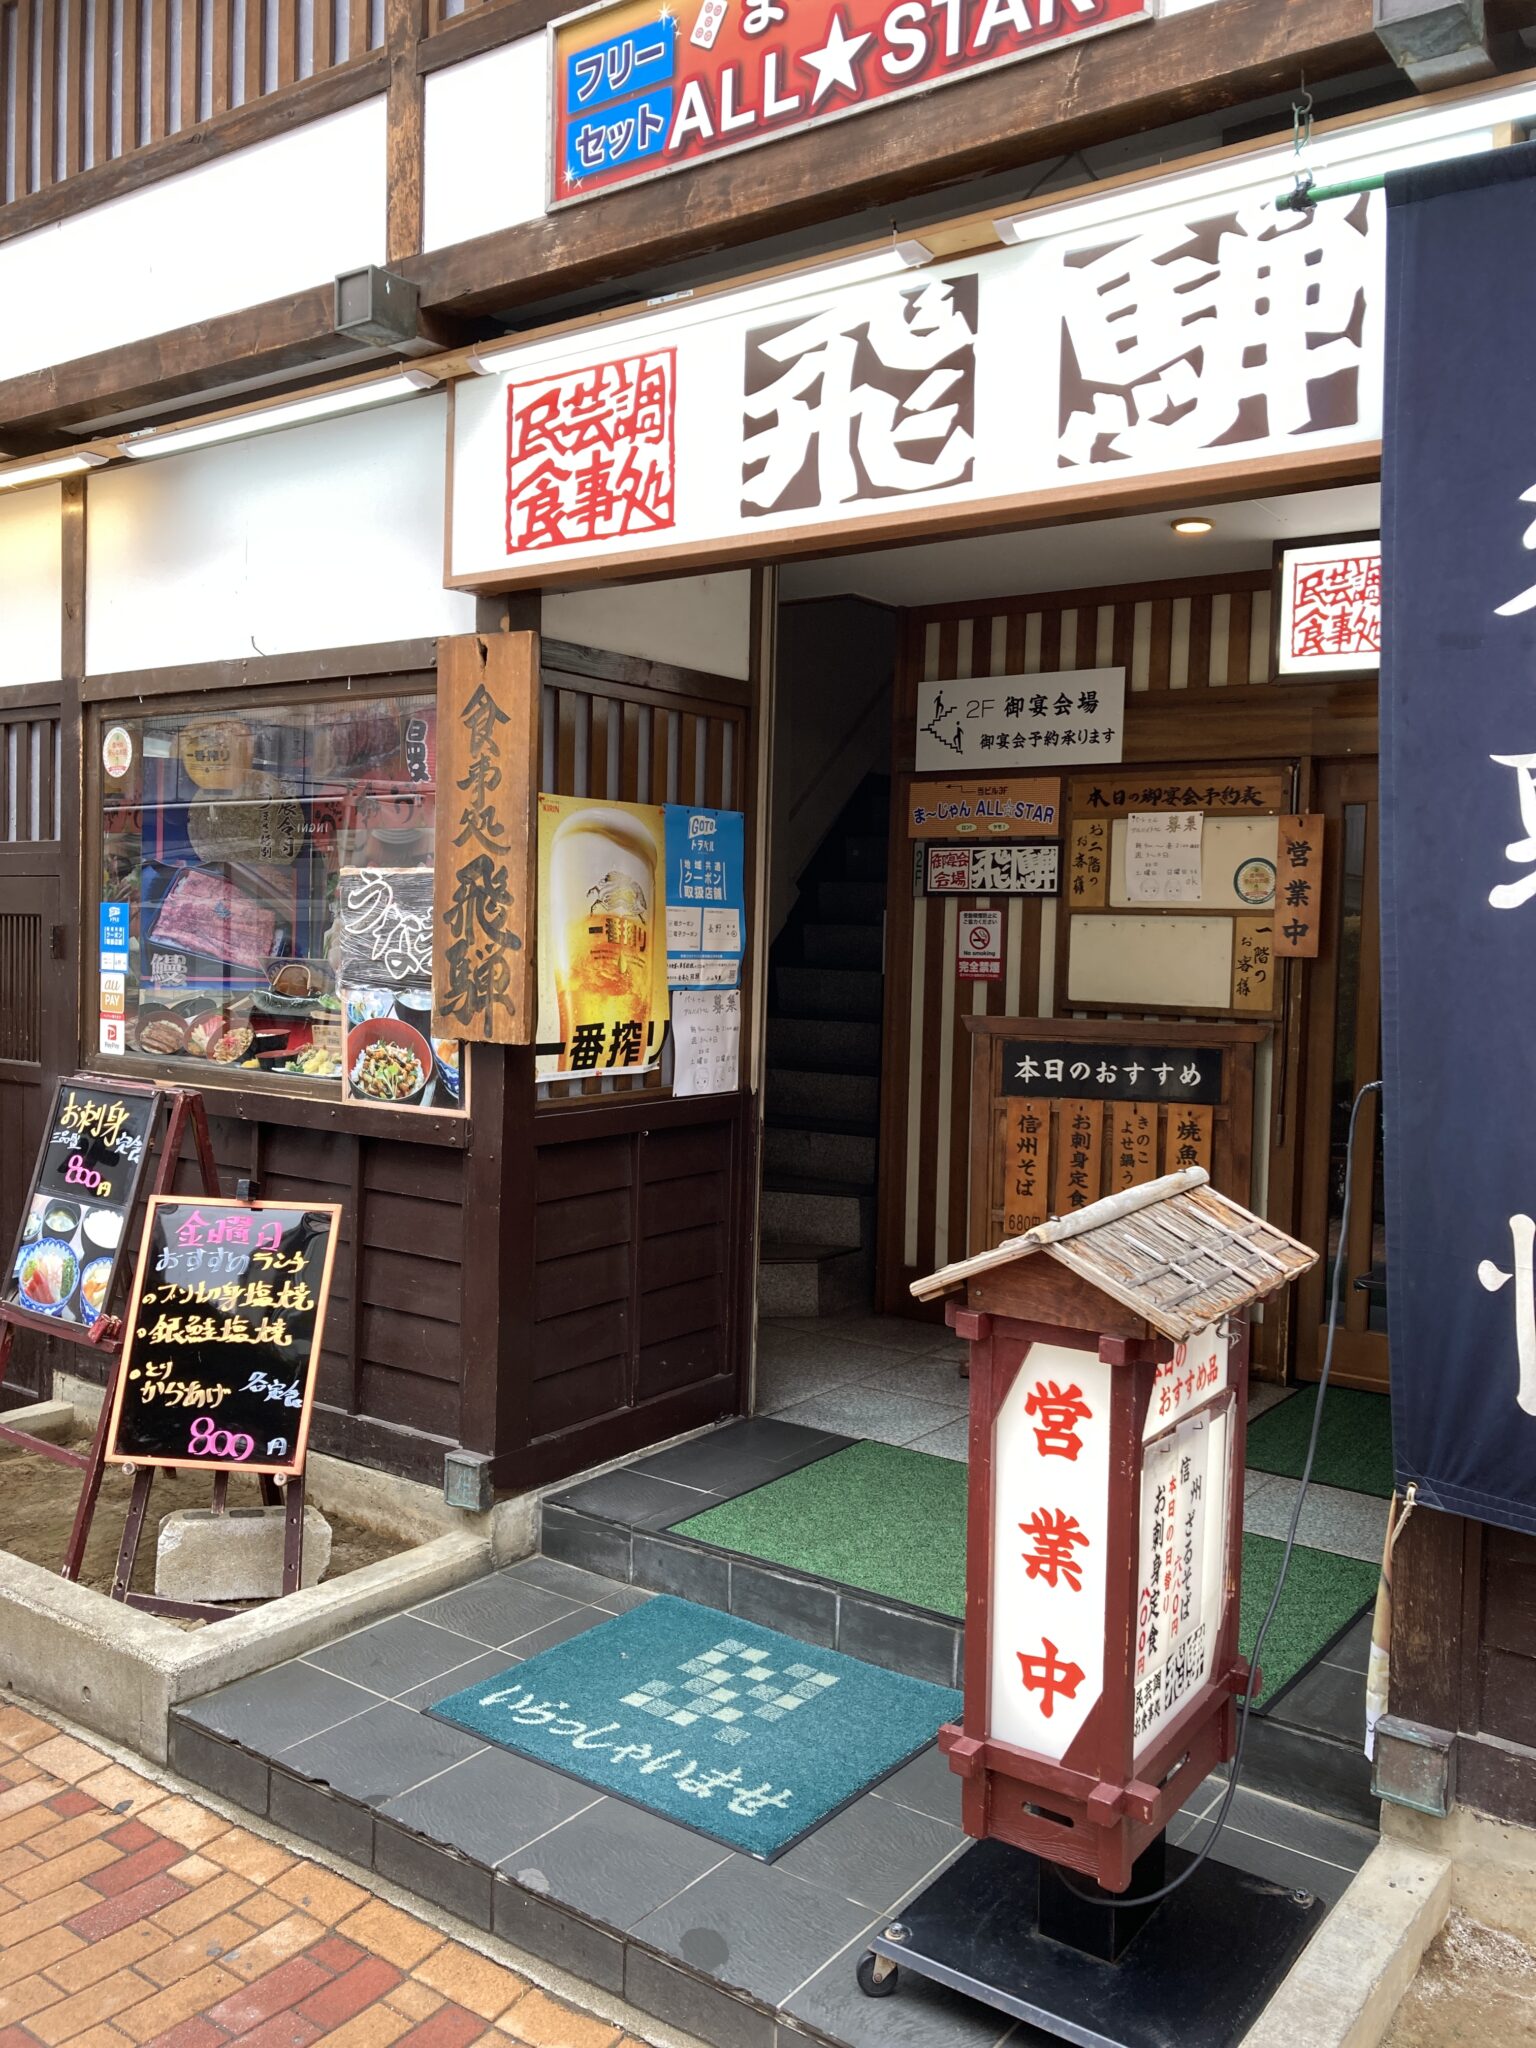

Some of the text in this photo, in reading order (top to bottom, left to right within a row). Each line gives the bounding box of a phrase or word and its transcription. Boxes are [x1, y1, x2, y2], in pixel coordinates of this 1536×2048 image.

[575, 39, 665, 102] フリー
[575, 102, 665, 168] セット
[511, 357, 666, 466] 民芸調
[509, 445, 671, 547] 食事処
[966, 689, 1100, 720] 2F 御宴会場
[979, 726, 1116, 750] 御宴会予約承ります
[542, 803, 560, 814] KIRIN
[1086, 785, 1266, 808] 本日の御宴会予約表
[684, 871, 721, 885] クーポン
[931, 851, 970, 869] 御宴会
[933, 870, 966, 887] 会場
[1281, 840, 1313, 947] 営業中
[588, 917, 647, 952] 一番搾り
[104, 978, 120, 991] au
[958, 960, 1001, 974] 完全禁煙
[104, 993, 120, 1007] PAY
[535, 1019, 670, 1072] 一番搾り
[1013, 1054, 1202, 1087] 本日のおすすめ
[60, 1091, 130, 1147] お刺身
[1136, 1115, 1151, 1165] きのこ
[1175, 1119, 1203, 1166] 焼魚
[1015, 1114, 1042, 1198] 信州そば
[1067, 1114, 1092, 1209] お刺身定食
[1120, 1119, 1136, 1190] よせ鍋う
[175, 1209, 284, 1252] 金曜日
[145, 1360, 174, 1380] とり
[1159, 1353, 1219, 1416] おすすめ品
[139, 1380, 232, 1409] からあげ
[1016, 1379, 1094, 1719] 営業中
[1147, 1484, 1166, 1657] お刺身定食
[478, 1684, 793, 1817] いらっしゃいませ
